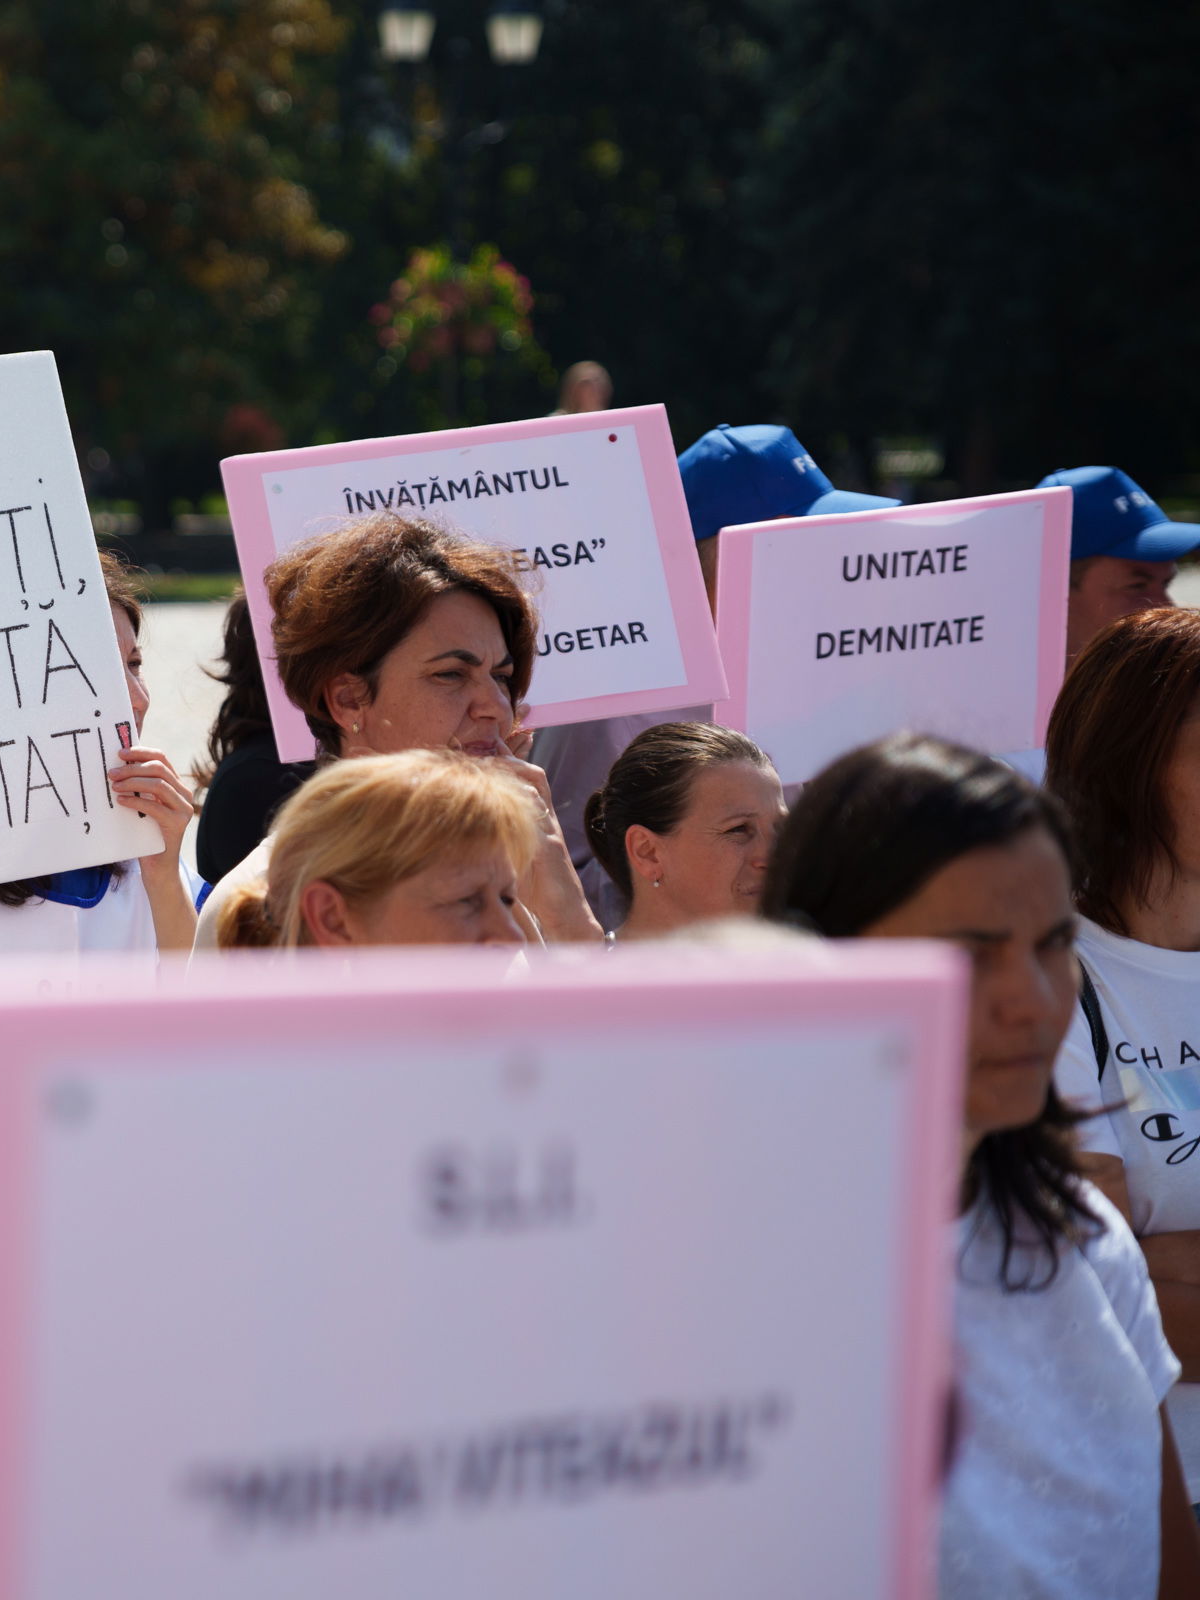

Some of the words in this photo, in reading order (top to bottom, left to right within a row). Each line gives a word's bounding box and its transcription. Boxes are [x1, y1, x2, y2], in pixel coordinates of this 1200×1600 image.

[343, 466, 569, 514] ÎNVĂȚĂMÂNTUL
[842, 544, 969, 582] UNITATE
[815, 615, 985, 659] DEMNITATE
